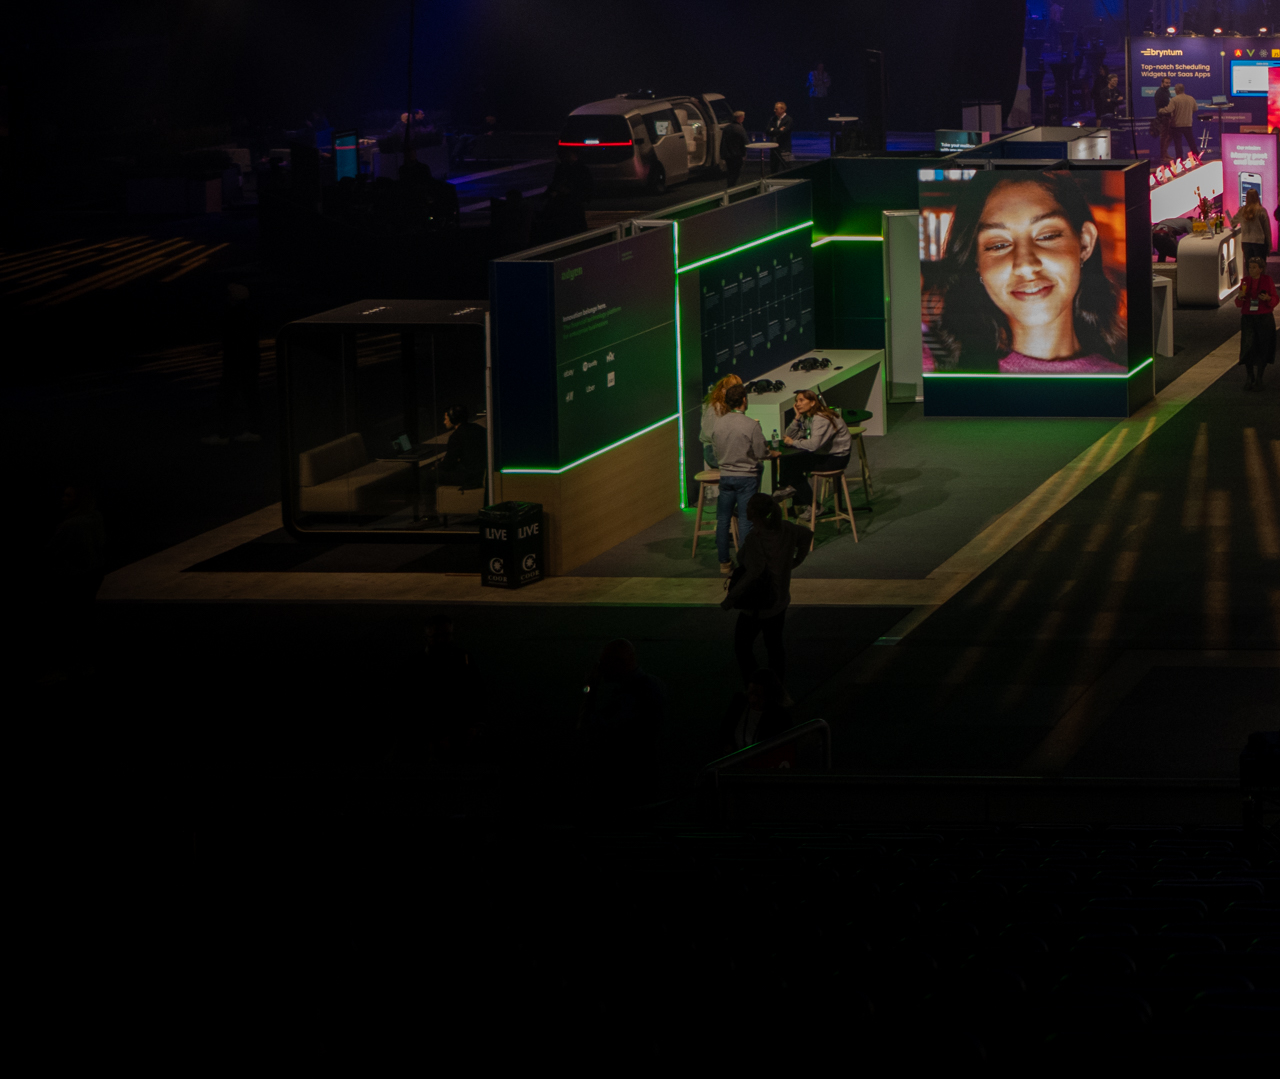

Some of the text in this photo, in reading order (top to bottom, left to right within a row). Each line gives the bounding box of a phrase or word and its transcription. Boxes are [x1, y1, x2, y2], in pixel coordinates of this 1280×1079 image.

[1150, 48, 1183, 57] bryntum
[1141, 63, 1210, 72] Top-notch Scheduling
[1141, 71, 1167, 79] Widgets
[1194, 71, 1211, 79] Apps
[484, 527, 508, 540] LIVE
[517, 522, 540, 539] LIVE
